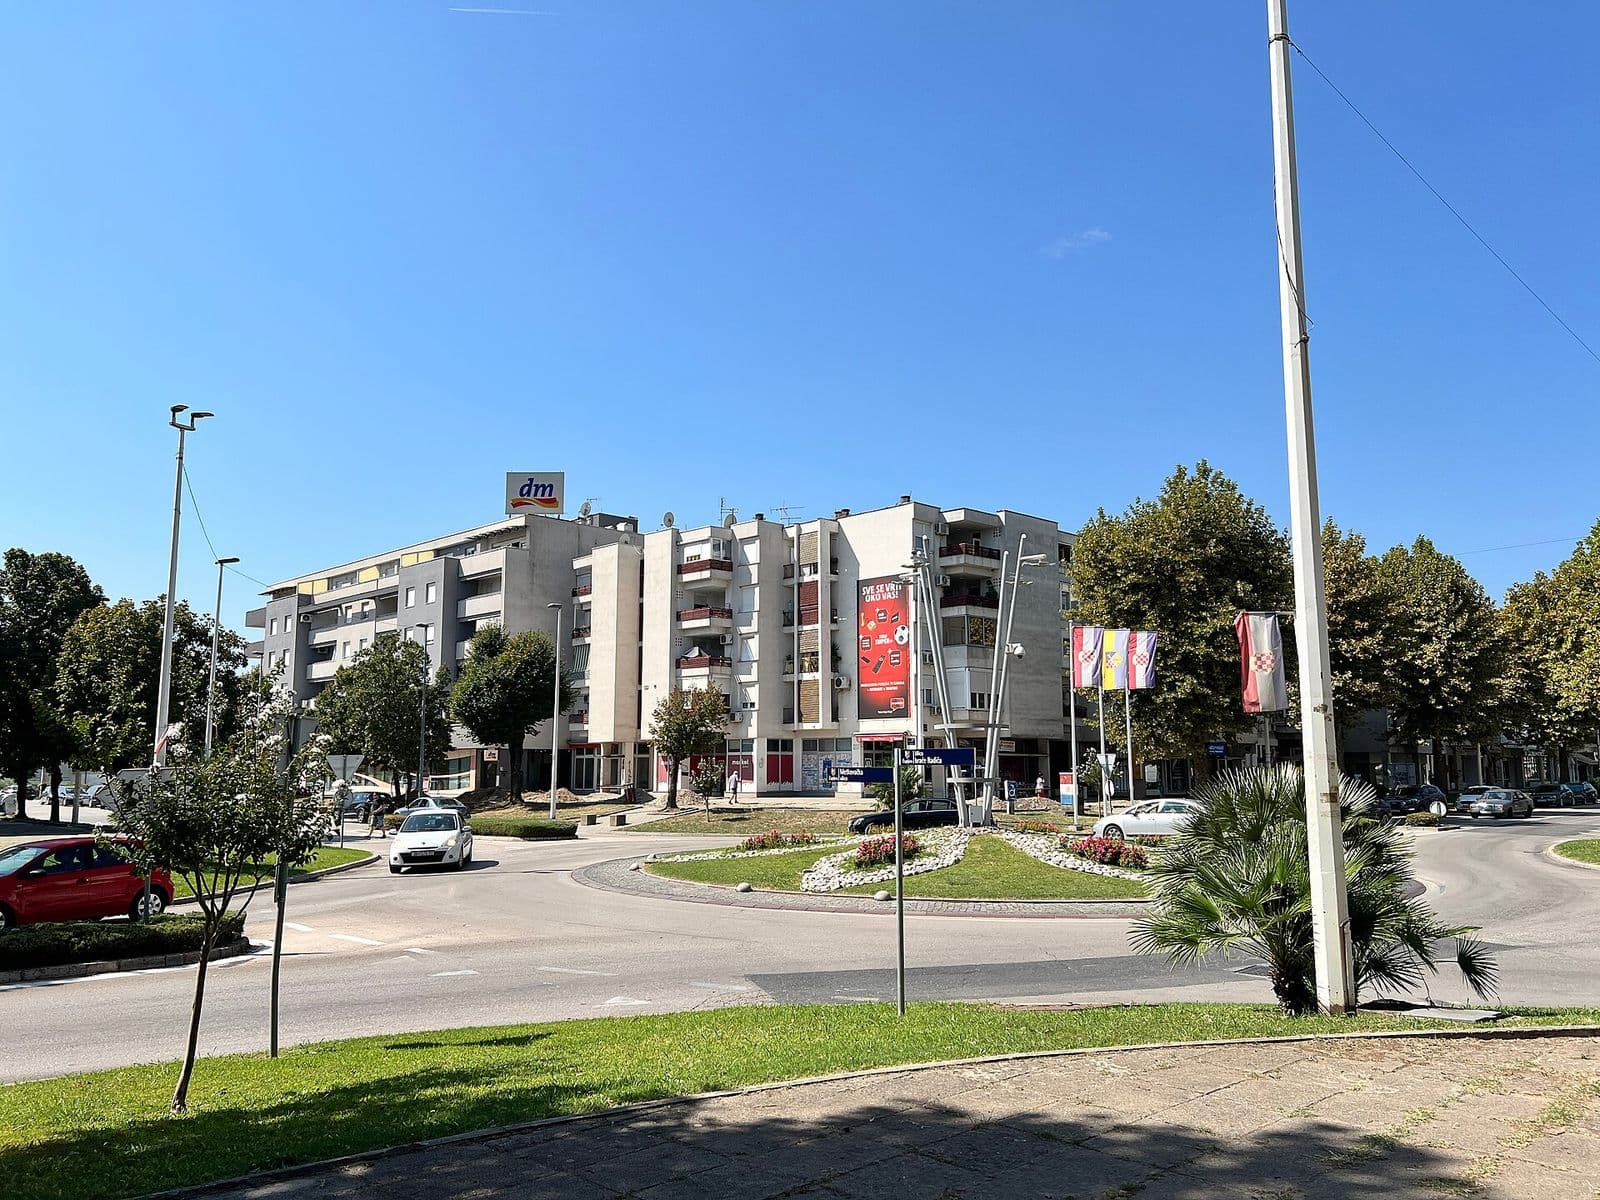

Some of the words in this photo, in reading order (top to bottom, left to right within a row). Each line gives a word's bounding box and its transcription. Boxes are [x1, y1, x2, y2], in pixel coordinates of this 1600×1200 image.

[519, 477, 554, 497] dm
[862, 586, 876, 596] SVE
[875, 583, 885, 593] SE
[864, 593, 881, 603] OKO
[881, 591, 899, 600] VAS!
